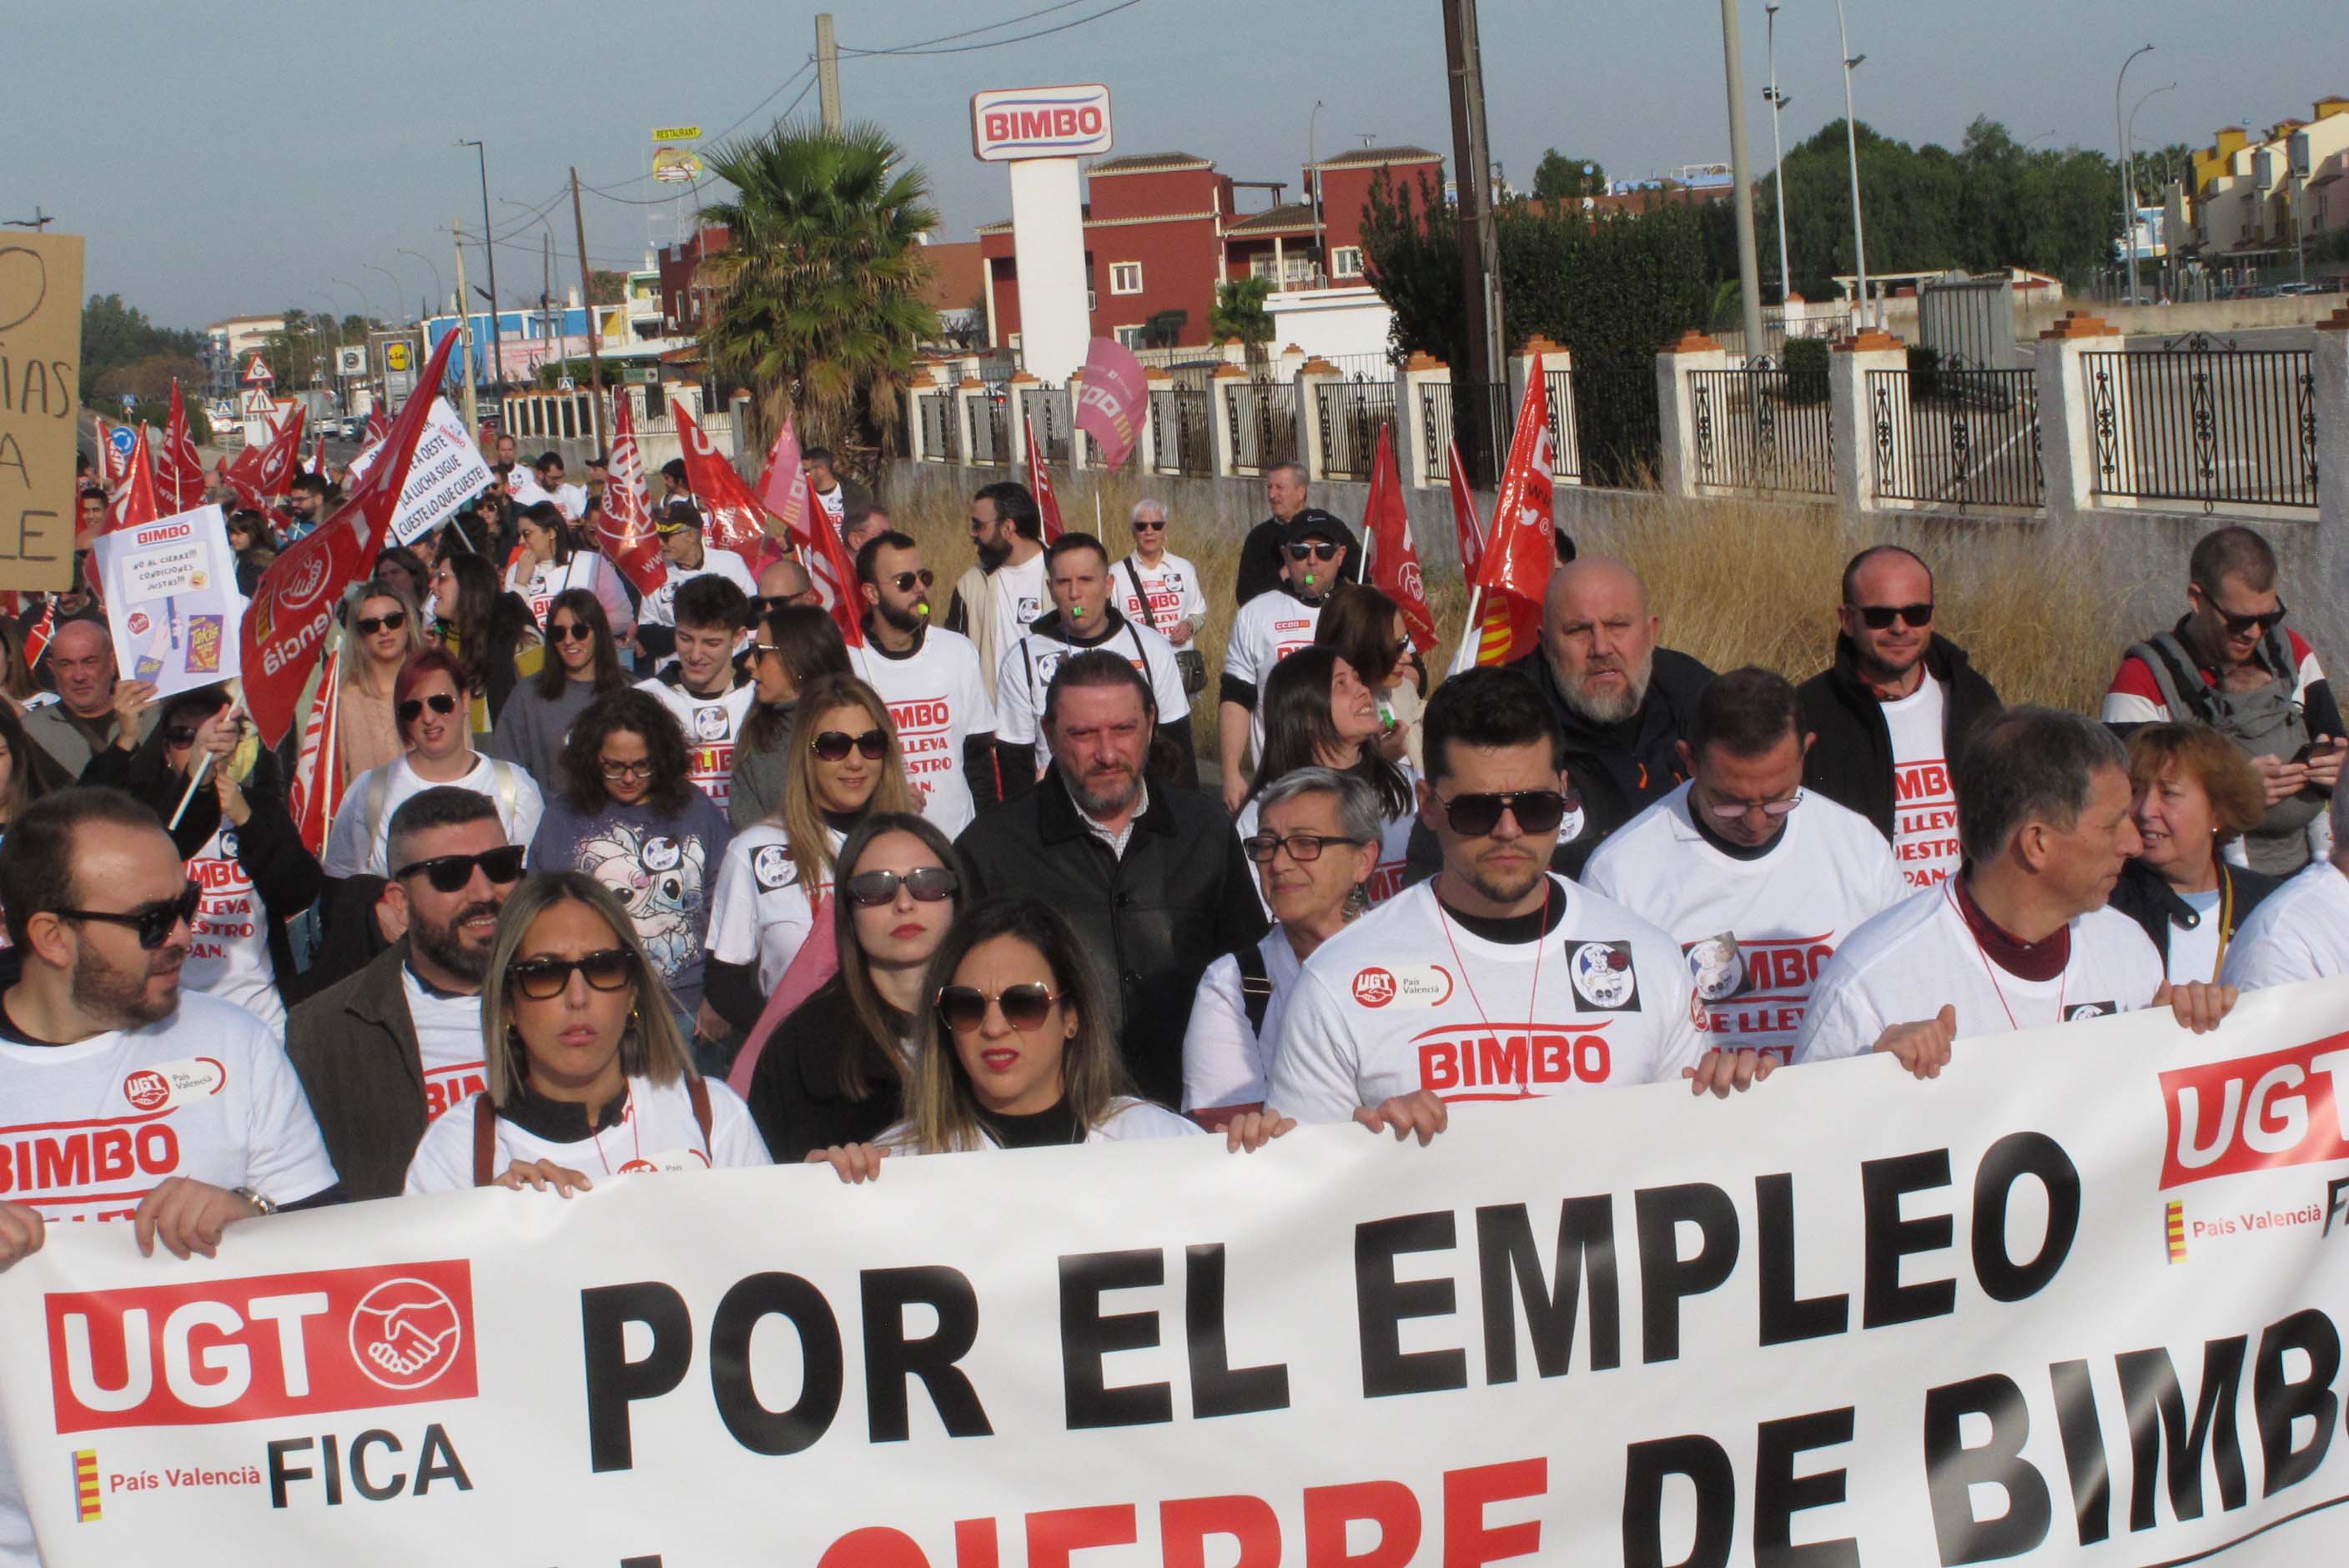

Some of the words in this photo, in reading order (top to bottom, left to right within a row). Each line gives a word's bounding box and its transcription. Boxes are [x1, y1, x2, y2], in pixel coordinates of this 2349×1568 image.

[985, 106, 1102, 142] BIMBO
[420, 434, 448, 460] OESTE
[413, 471, 440, 498] LUCHA
[439, 454, 463, 480] SIGUE
[398, 505, 431, 536] CUESTE
[425, 498, 440, 516] LO
[440, 486, 457, 508] QUE
[453, 465, 487, 496] CUESTE!
[137, 524, 191, 545] BIMBO
[889, 701, 949, 731] MBO
[1894, 766, 1954, 802] MB
[1902, 810, 1960, 834] LLEV
[1358, 973, 1391, 991] UGT
[1419, 1033, 1612, 1092] BIMBO
[127, 1073, 162, 1098] UGT
[2193, 1216, 2237, 1239] País
[2239, 1203, 2321, 1232] Valencià
[581, 1264, 995, 1474] POR
[1058, 1242, 1290, 1431] EL
[1354, 1130, 2082, 1399] EMPLEO
[63, 1290, 329, 1412] UGT
[1923, 1307, 2349, 1568] BIMB
[109, 1468, 159, 1495] País
[164, 1465, 261, 1491] Valencià
[267, 1422, 475, 1509] FICA
